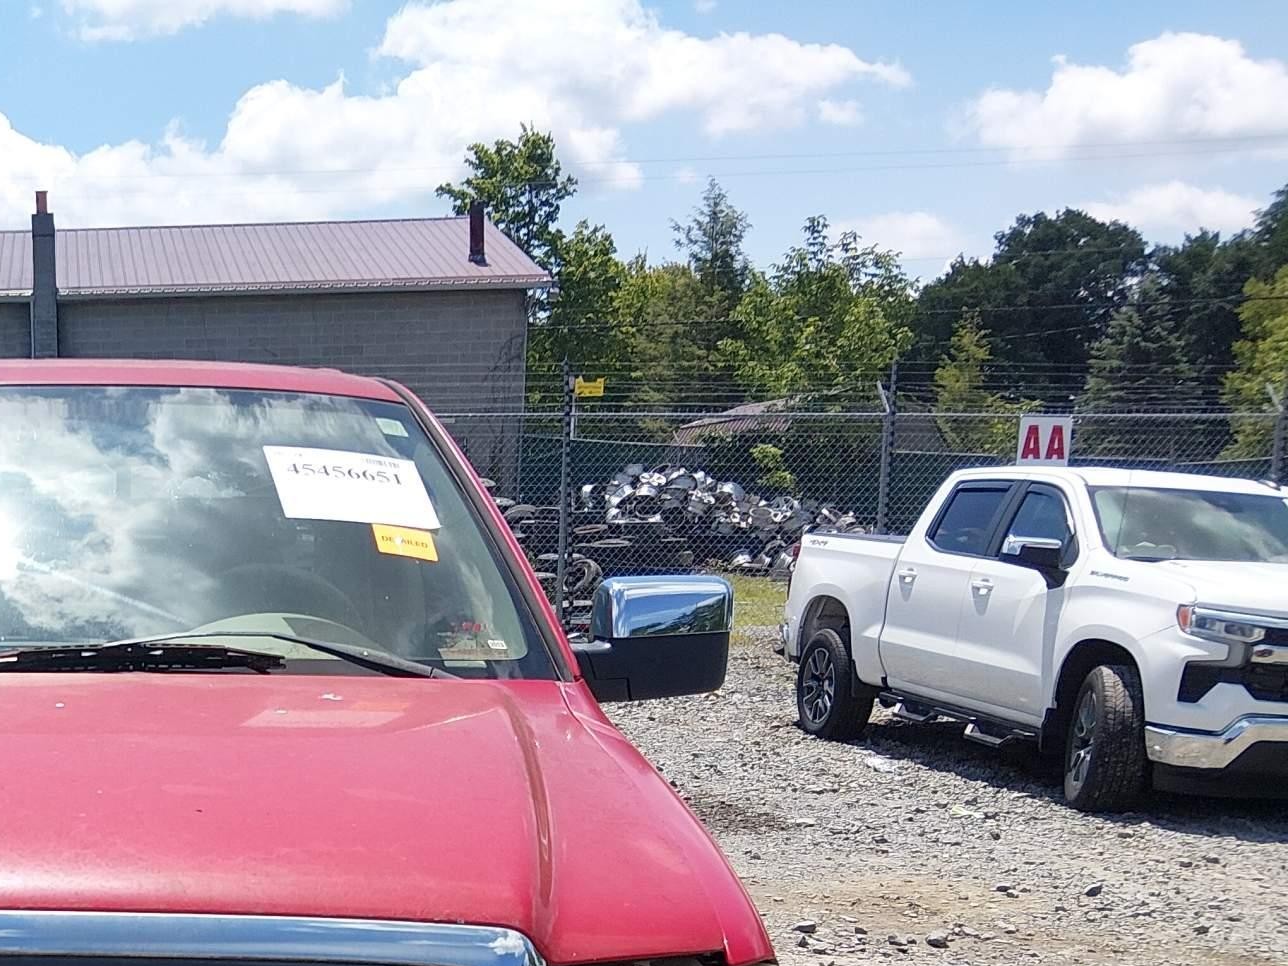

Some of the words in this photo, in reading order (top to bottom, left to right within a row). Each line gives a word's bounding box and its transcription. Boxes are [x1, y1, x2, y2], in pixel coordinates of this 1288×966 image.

[1021, 424, 1065, 460] AA
[287, 463, 402, 485] 45456651
[381, 534, 429, 549] DEAILED
